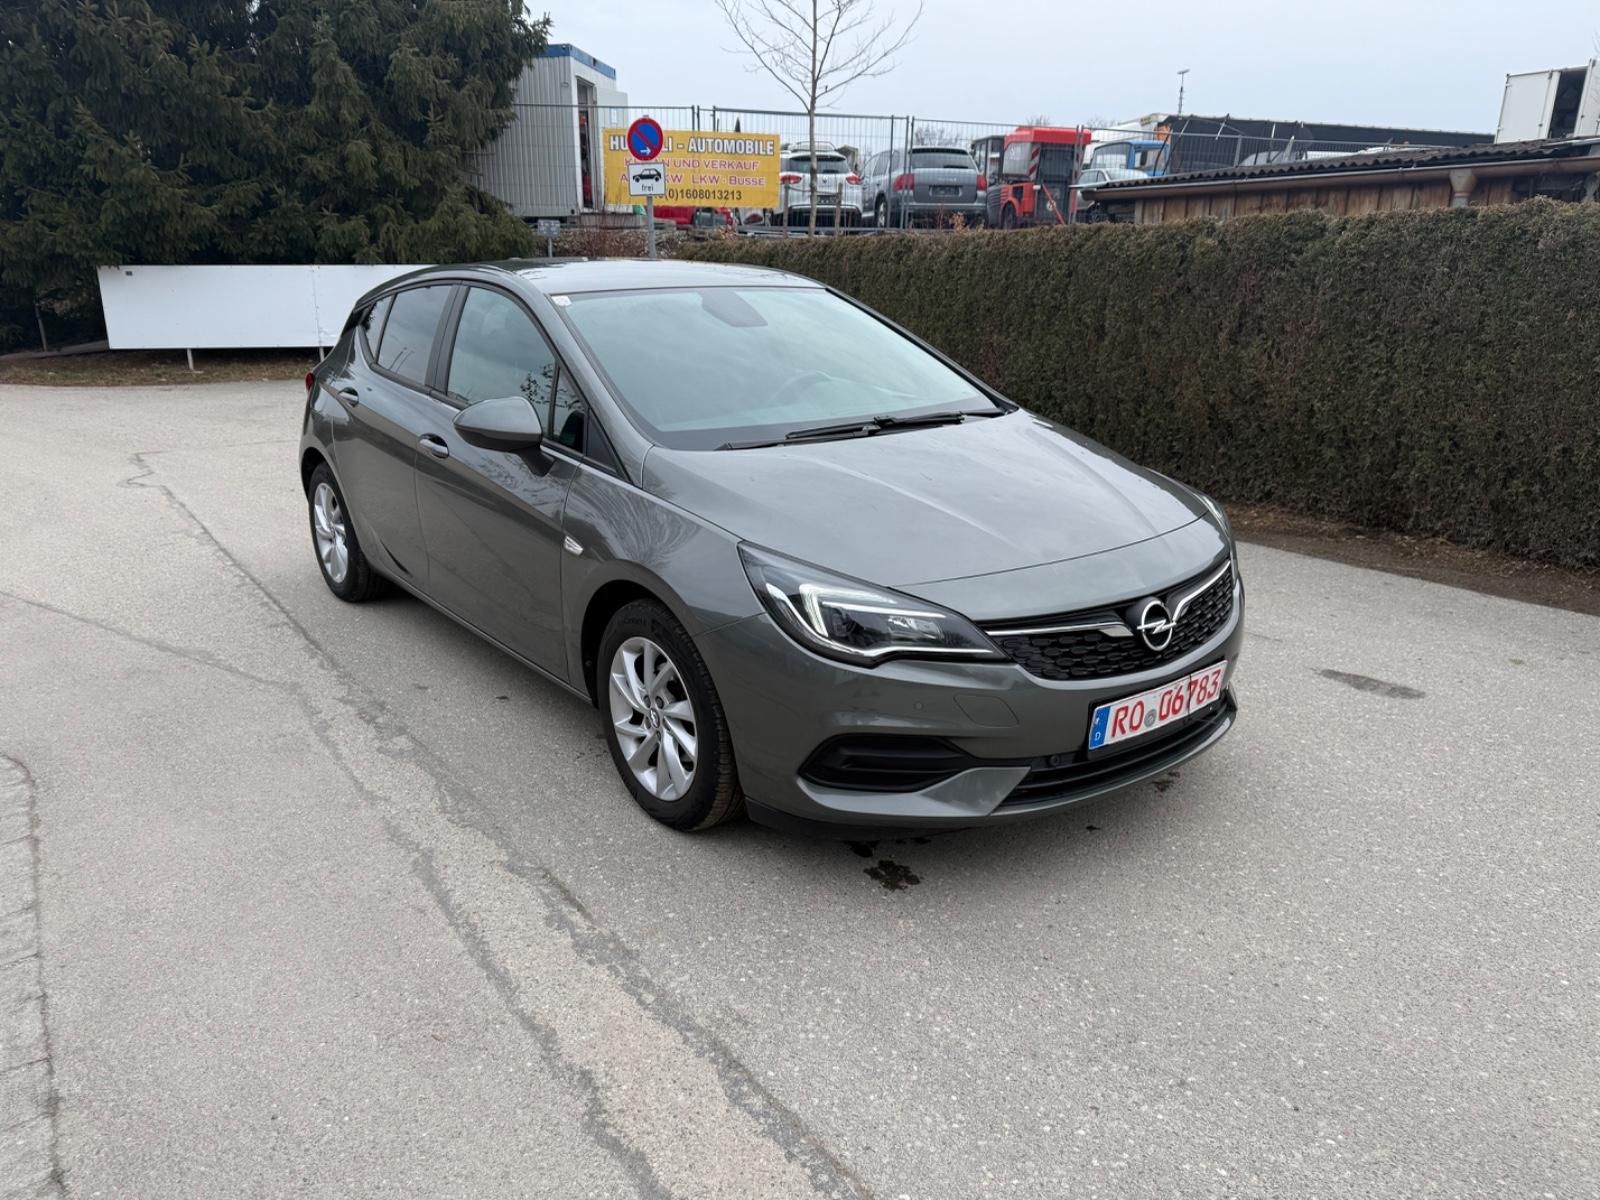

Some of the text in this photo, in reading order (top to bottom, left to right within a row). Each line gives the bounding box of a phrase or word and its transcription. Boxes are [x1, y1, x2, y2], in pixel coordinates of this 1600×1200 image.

[609, 135, 673, 152] HULI
[688, 137, 774, 156] AUTOMOBILE
[673, 159, 700, 169] UND
[703, 159, 760, 170] VERKAUF
[692, 175, 720, 185] LKW
[641, 184, 654, 192] frei
[1111, 669, 1222, 738] RO 06783
